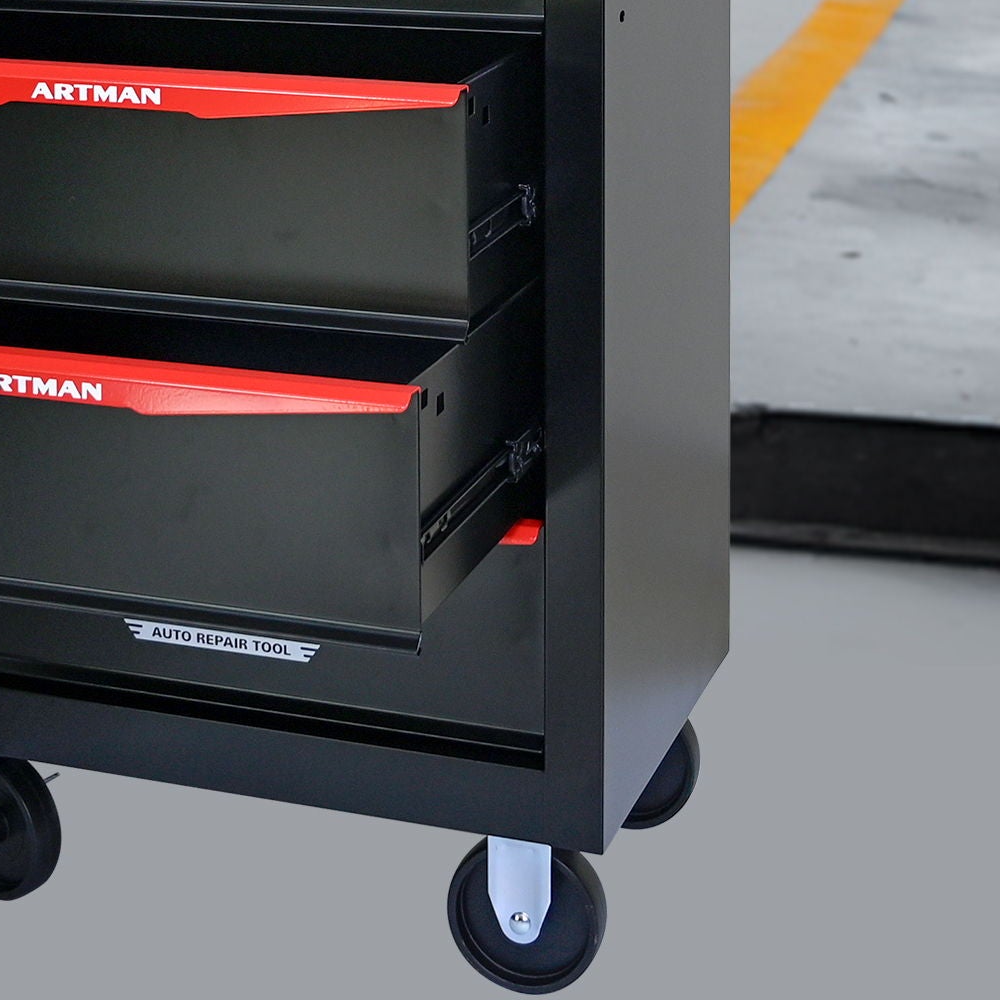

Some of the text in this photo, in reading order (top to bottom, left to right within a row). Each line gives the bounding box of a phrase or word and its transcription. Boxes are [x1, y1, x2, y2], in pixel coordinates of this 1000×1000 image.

[31, 82, 161, 105] ARTMAN
[152, 626, 292, 656] AUTO REPAIR TOOL
